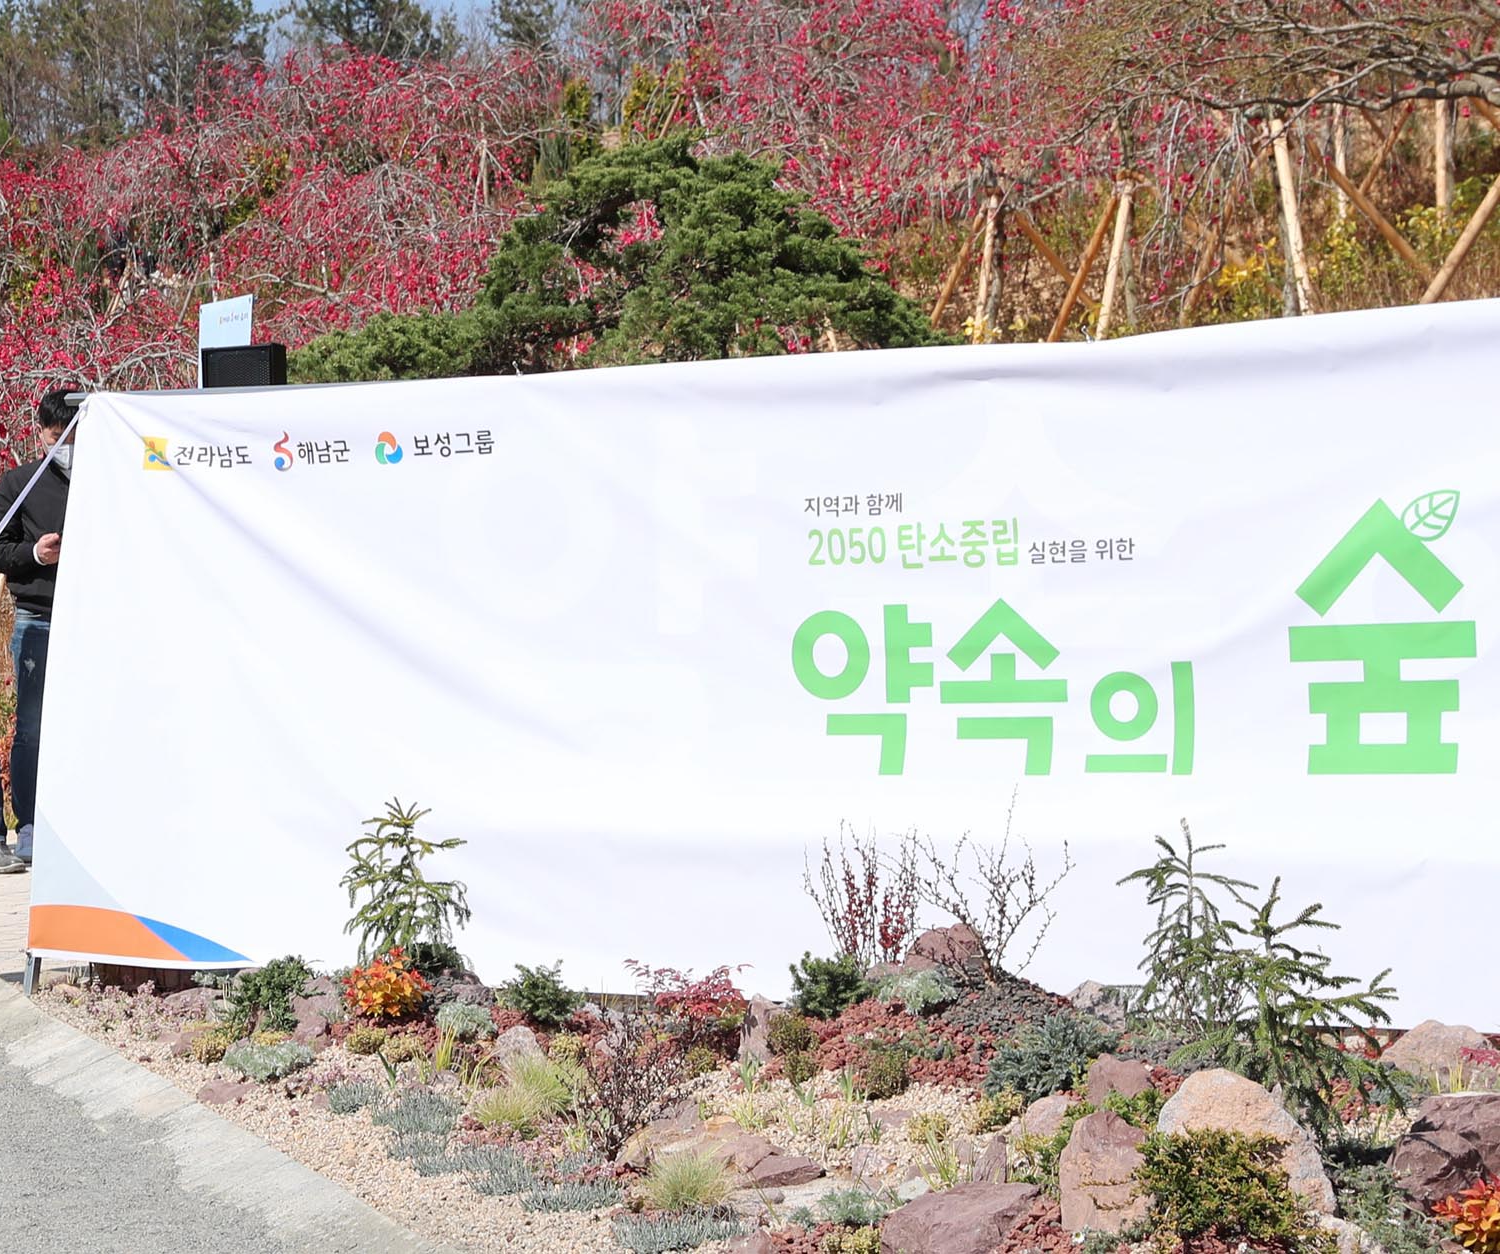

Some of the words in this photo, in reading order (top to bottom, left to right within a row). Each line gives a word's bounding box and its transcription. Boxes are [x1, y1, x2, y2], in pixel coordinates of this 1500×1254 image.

[173, 444, 254, 469] 전라남도
[296, 439, 351, 466] 해남군
[412, 429, 496, 459] 보성그룹
[803, 495, 860, 518] 지역과
[865, 492, 904, 517] 함께
[807, 526, 887, 566] 2050
[897, 517, 1020, 570] 탄소중립
[1027, 538, 1088, 566] 실현을
[1094, 536, 1136, 562] 위한
[792, 598, 1195, 775] 약속의
[1288, 496, 1477, 775] 숲
